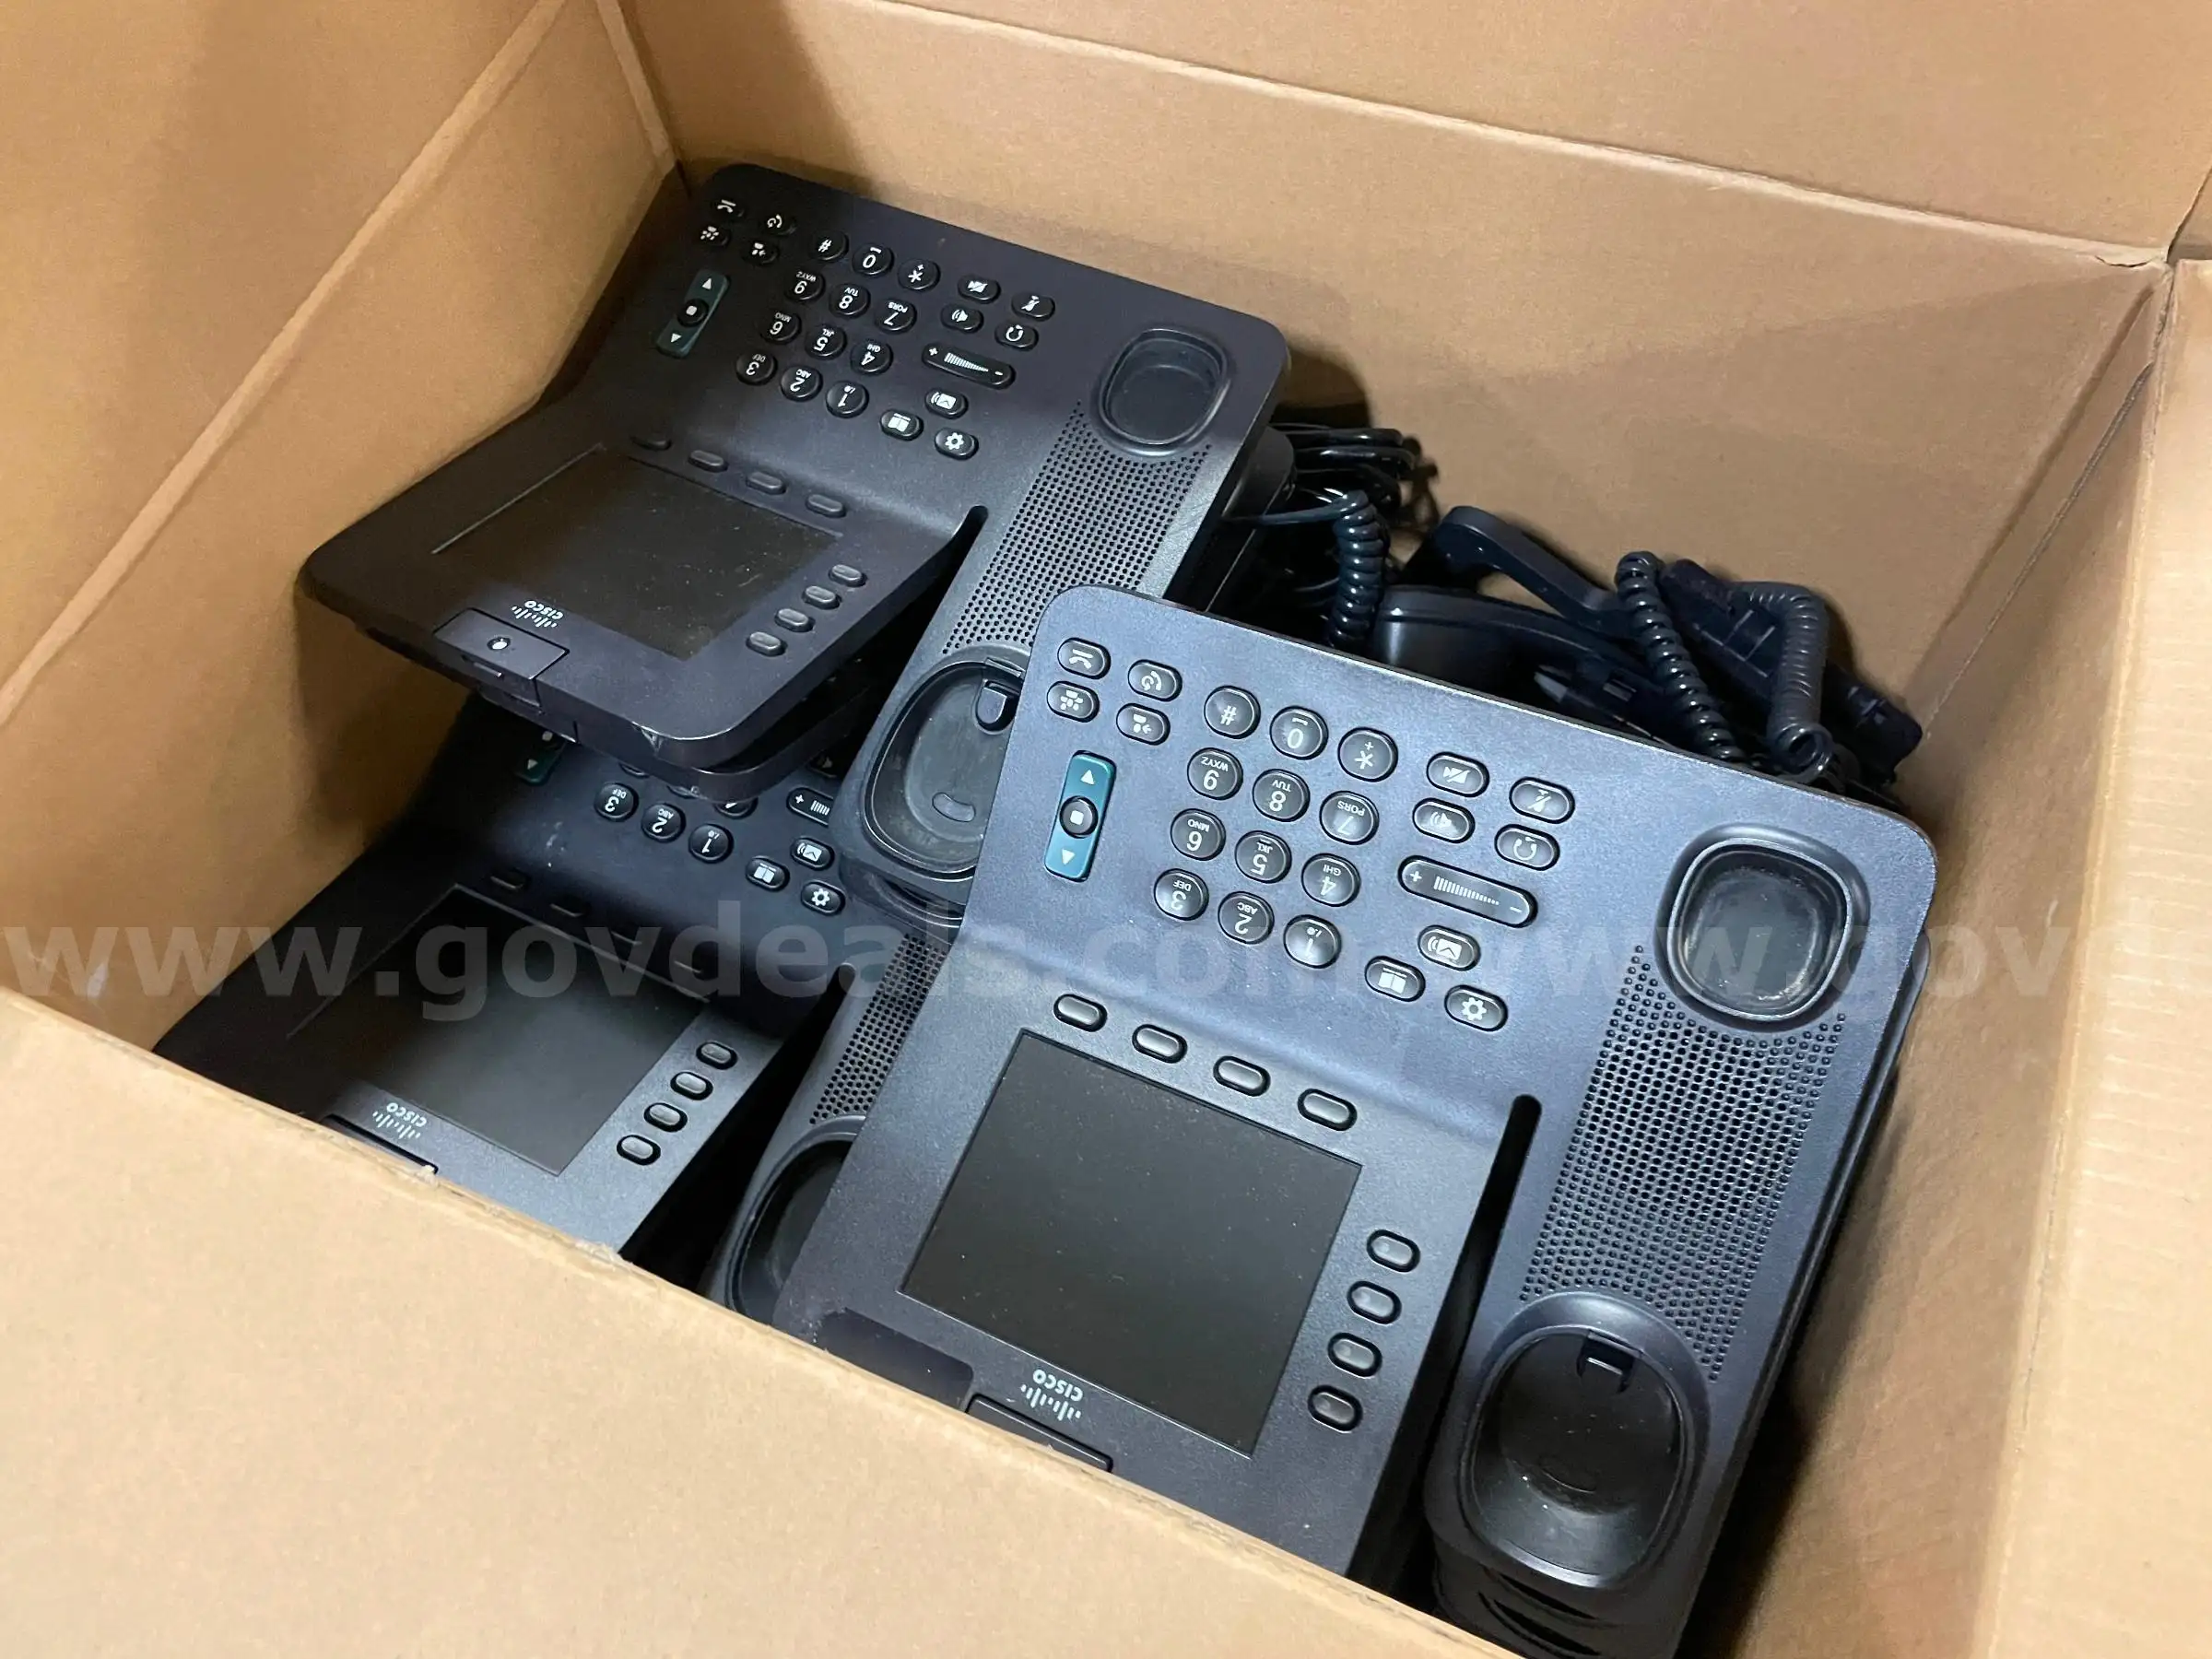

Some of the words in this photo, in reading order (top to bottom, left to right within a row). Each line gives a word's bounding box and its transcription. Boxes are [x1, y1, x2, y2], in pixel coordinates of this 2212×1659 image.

[818, 239, 831, 253] #
[863, 254, 877, 268] 0
[794, 280, 807, 294] 9
[844, 287, 859, 297] TUV
[839, 295, 853, 310] 8
[775, 312, 792, 323] MNO
[884, 312, 899, 326] 7
[770, 322, 782, 335] 6
[822, 328, 835, 337] JKL
[814, 336, 829, 352] 5
[867, 344, 881, 353] GHI
[752, 353, 766, 363] DEF
[861, 352, 876, 366] 4
[746, 361, 759, 375] 3
[795, 369, 812, 379] ABC
[790, 377, 806, 393] 2
[838, 394, 848, 407] 1
[524, 600, 563, 619] CISCO
[1220, 705, 1238, 726] #
[1287, 728, 1303, 749] 0
[1201, 757, 1229, 771] WXYZ
[1203, 769, 1219, 791] 9
[1272, 779, 1291, 792] TUV
[612, 789, 627, 799] DEF
[605, 796, 619, 813] 3
[1269, 791, 1287, 812] 8
[657, 808, 675, 819] ABC
[652, 816, 668, 833] 2
[1187, 819, 1210, 832] MNO
[1335, 815, 1355, 836] 7
[701, 838, 712, 853] 1
[1186, 830, 1203, 852] 6
[1256, 842, 1273, 853] JKL
[1251, 853, 1268, 876] 5
[1323, 864, 1341, 877] GHI
[1173, 881, 1192, 892] DEF
[1320, 877, 1336, 896] 4
[1171, 890, 1187, 912] 3
[1237, 902, 1258, 916] ABC
[1234, 912, 1253, 935] 2
[1304, 938, 1314, 958] 1
[386, 1102, 427, 1127] CISCO
[1033, 1369, 1083, 1401] CISCO
